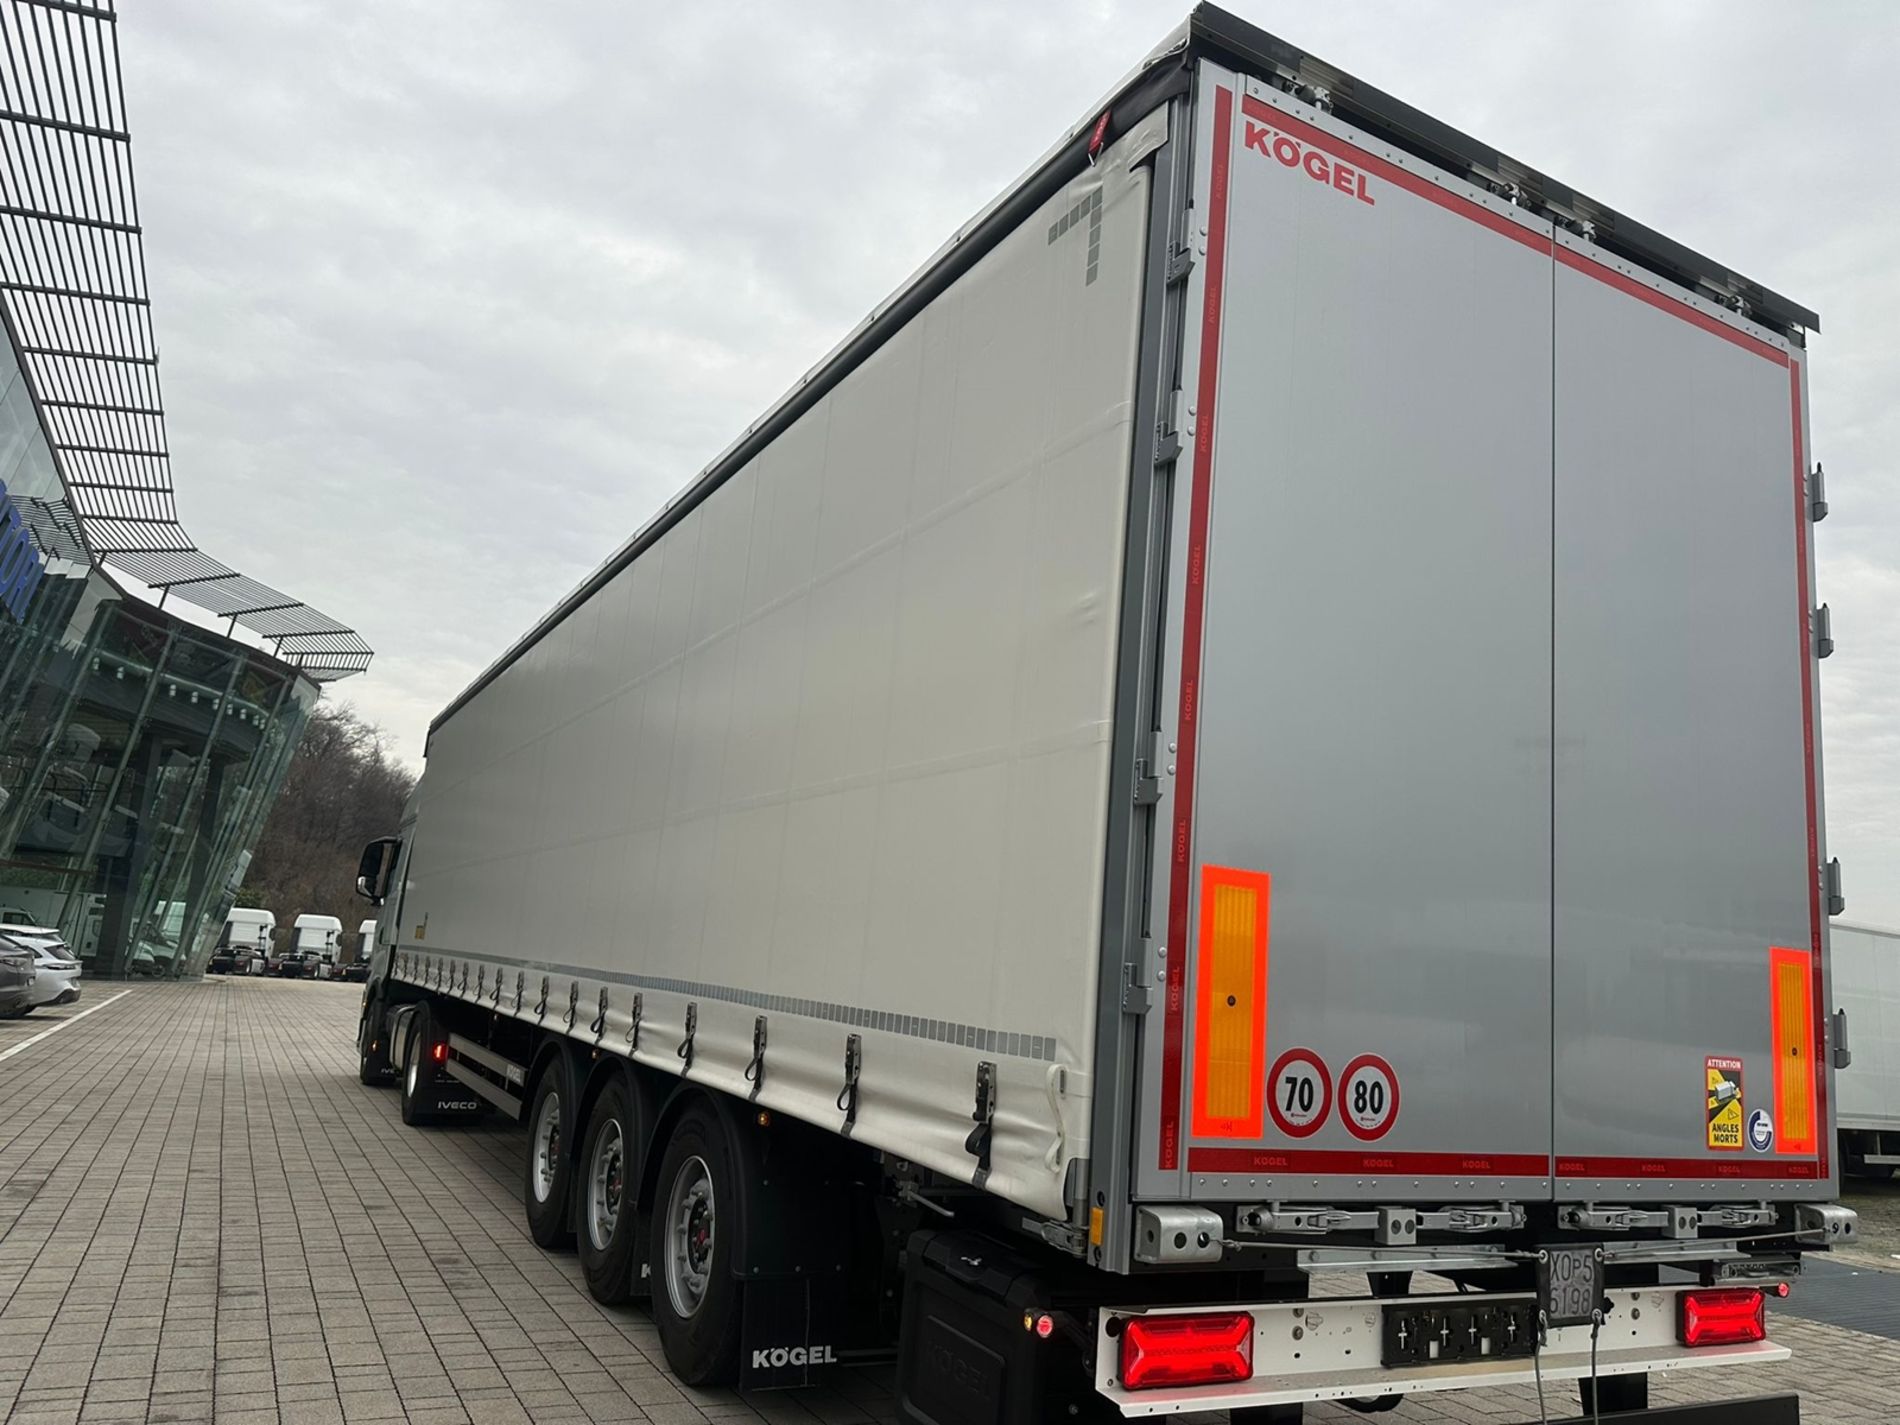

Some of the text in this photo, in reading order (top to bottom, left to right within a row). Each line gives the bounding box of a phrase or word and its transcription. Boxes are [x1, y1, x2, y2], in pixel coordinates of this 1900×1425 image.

[1244, 120, 1375, 206] KÖGEL
[1707, 1059, 1741, 1069] ATTENTION
[437, 1101, 477, 1110] IVECO
[1285, 1076, 1314, 1112] 70
[1354, 1080, 1383, 1114] 80
[1712, 1123, 1739, 1133] ANGLES
[1713, 1134, 1738, 1143] MORTS
[1550, 1287, 1591, 1315] 6198
[752, 1345, 837, 1368] KÖGEL
